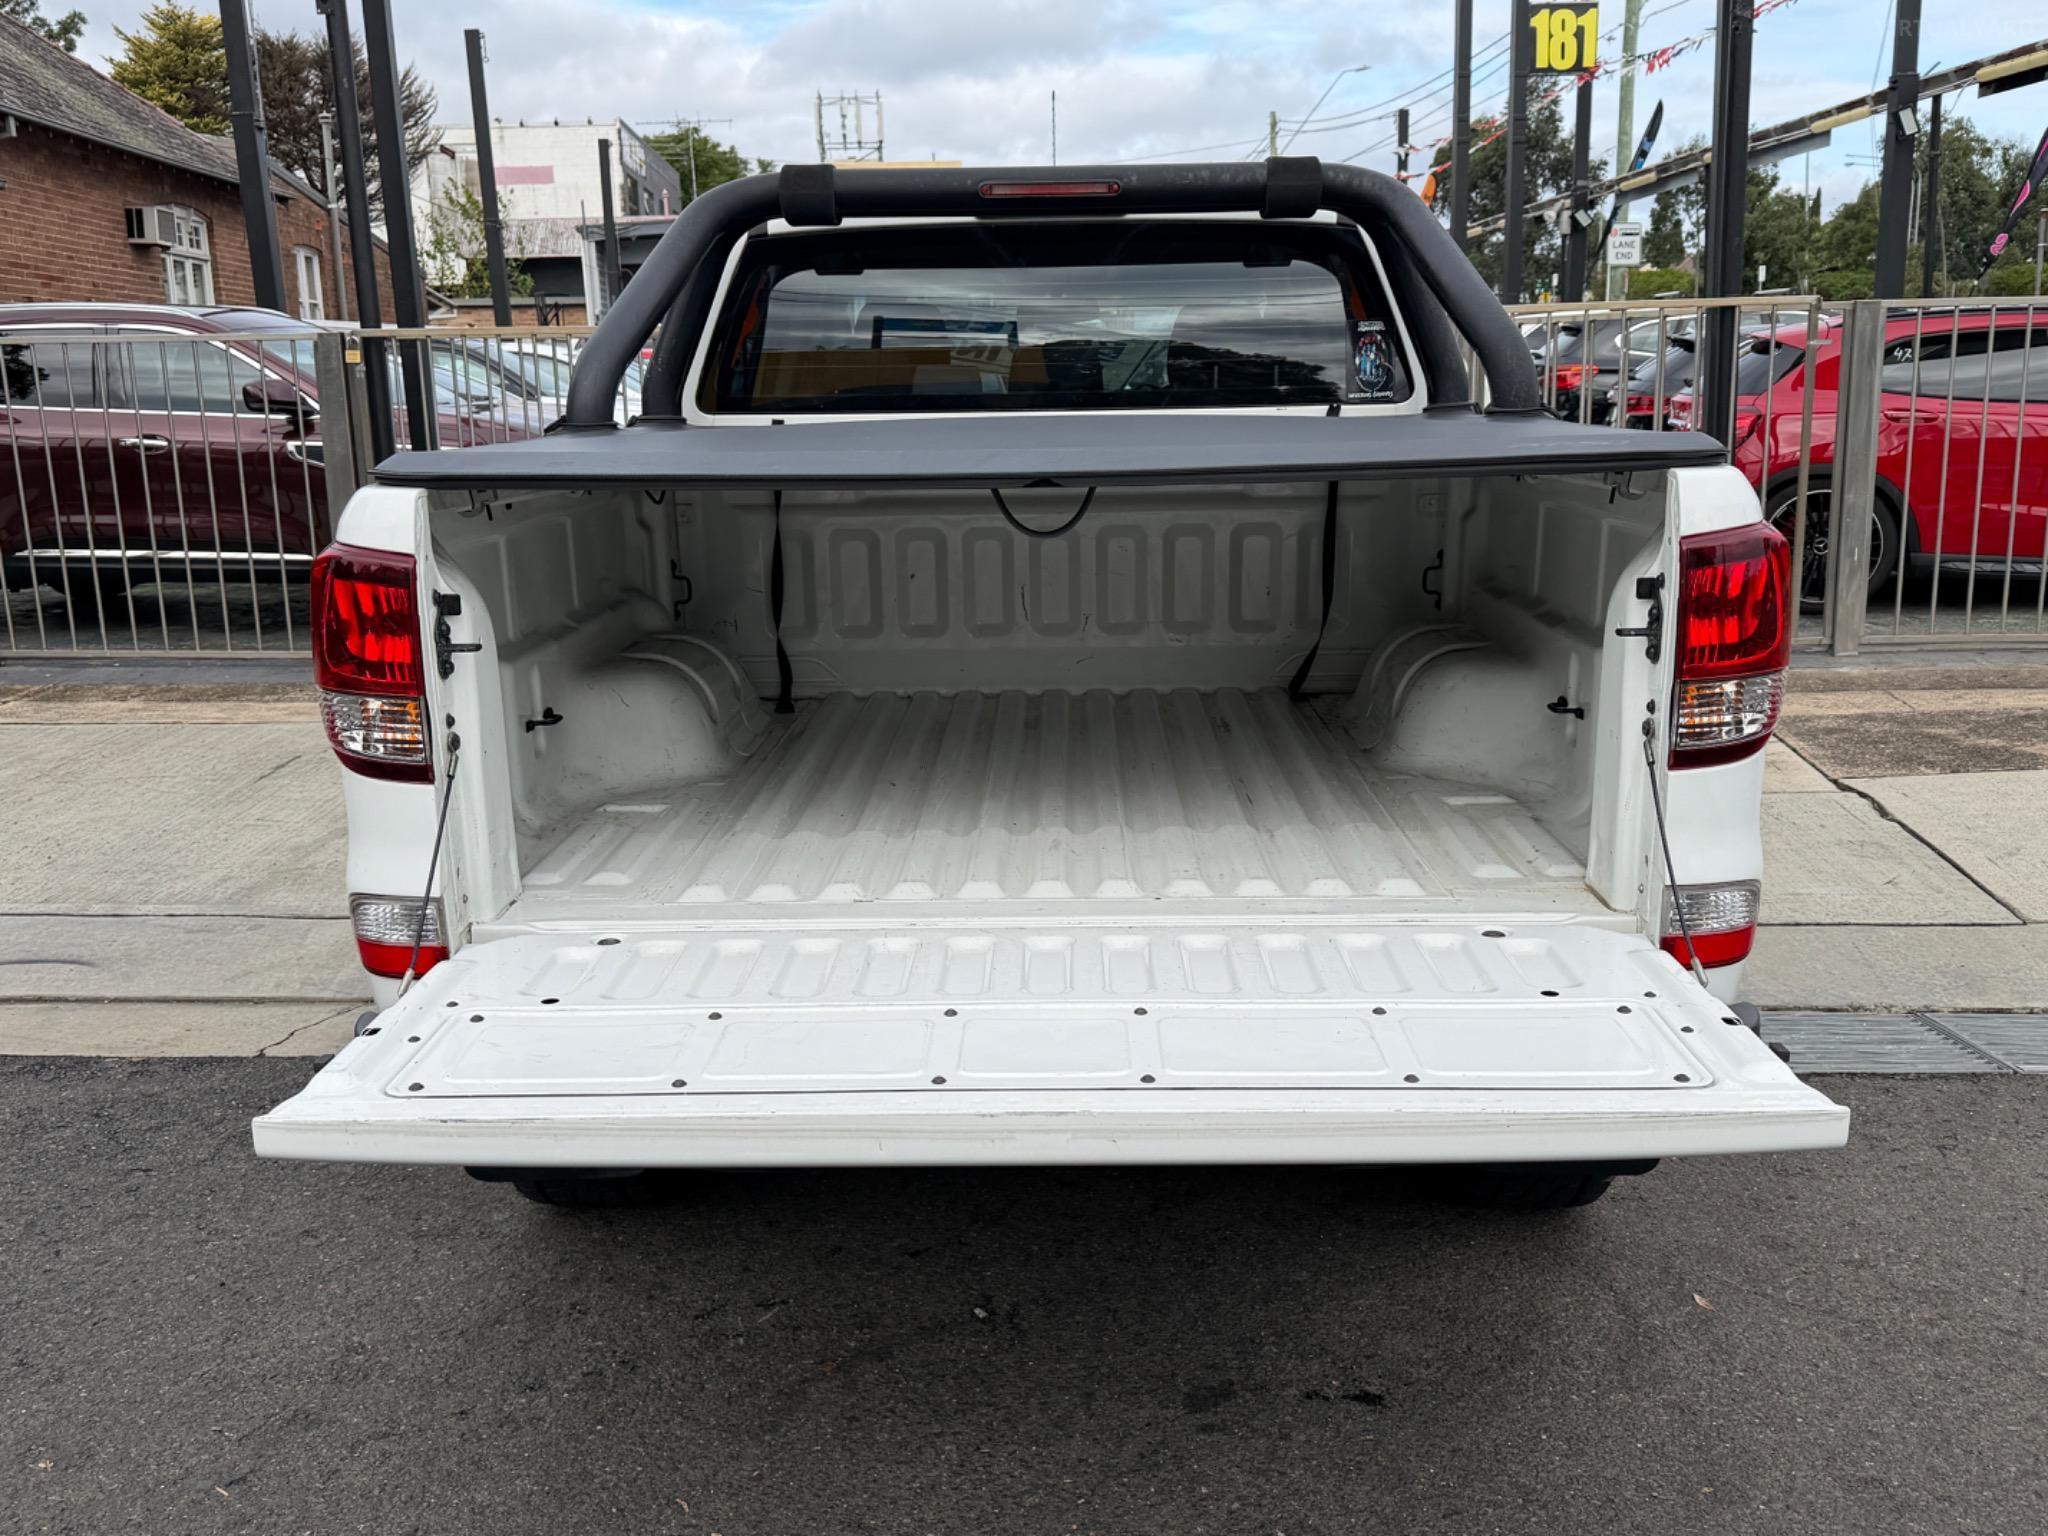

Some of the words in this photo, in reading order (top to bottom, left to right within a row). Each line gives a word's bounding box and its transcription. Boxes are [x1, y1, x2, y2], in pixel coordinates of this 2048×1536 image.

[1530, 8, 1597, 70] 181
[1612, 240, 1636, 249] LANE
[1615, 251, 1633, 260] END
